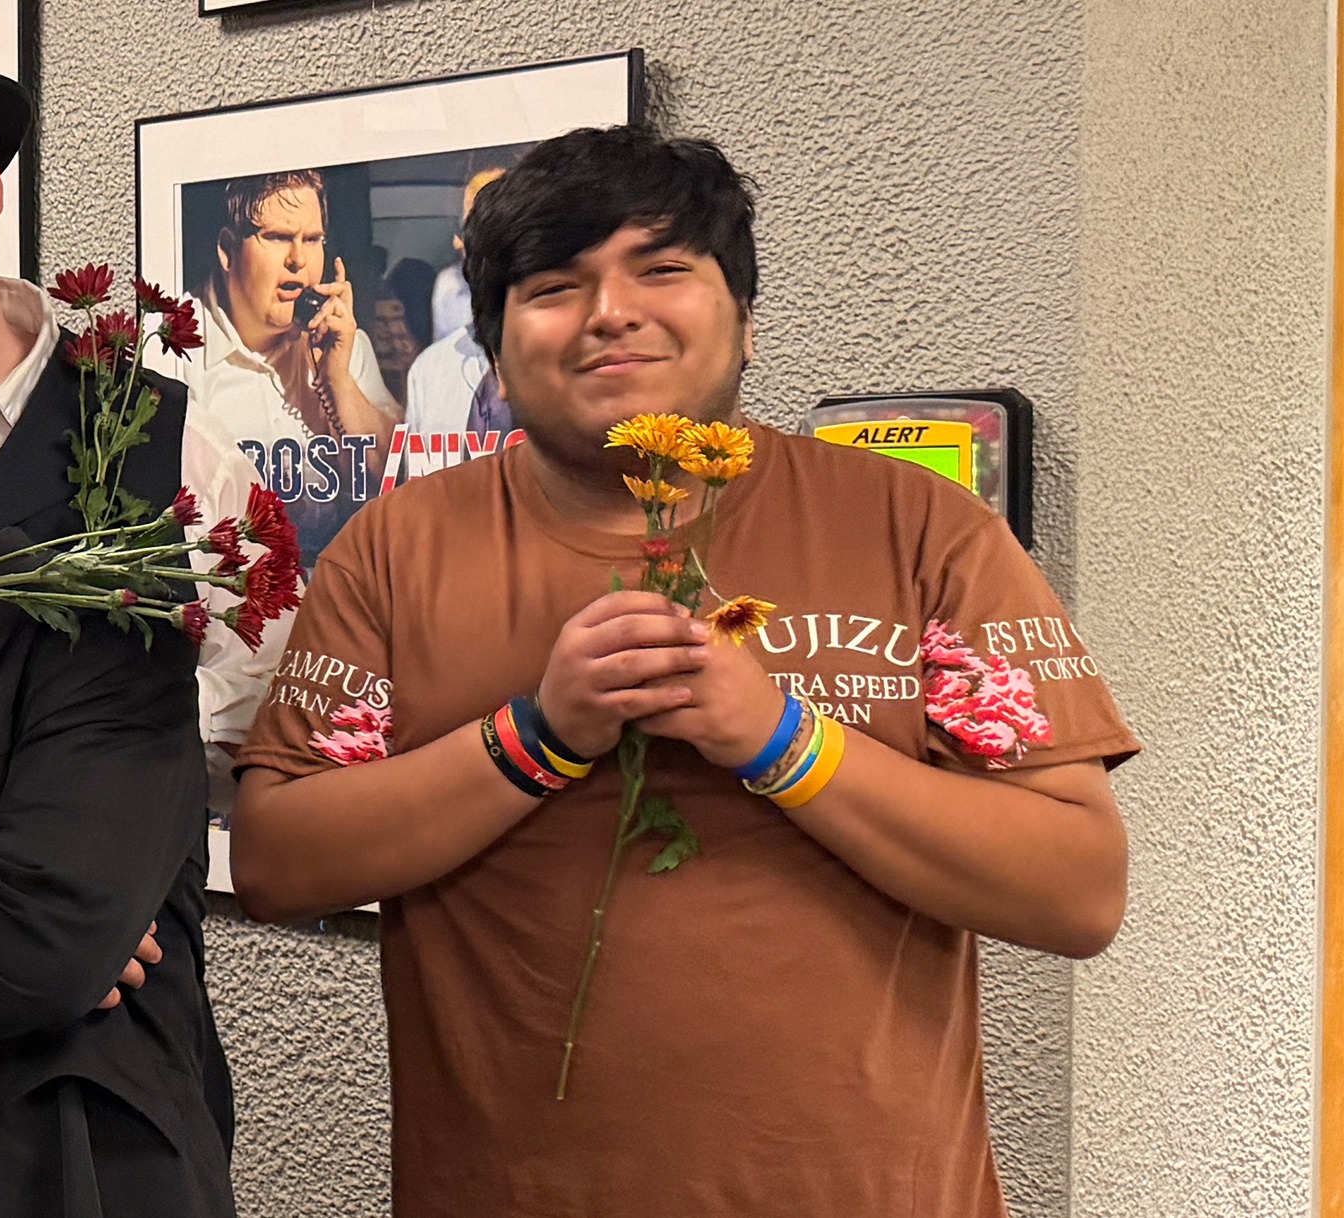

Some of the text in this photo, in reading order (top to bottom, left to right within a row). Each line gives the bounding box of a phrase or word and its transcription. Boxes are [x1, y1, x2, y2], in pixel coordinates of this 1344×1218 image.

[852, 426, 929, 444] ALERT
[756, 613, 921, 668] UJIZU
[1016, 616, 1072, 656] FUJI
[275, 650, 394, 709] CAMPUS
[1029, 655, 1099, 681] TOKYO
[768, 672, 920, 701] TRA SPEED
[817, 702, 872, 725] PAN
